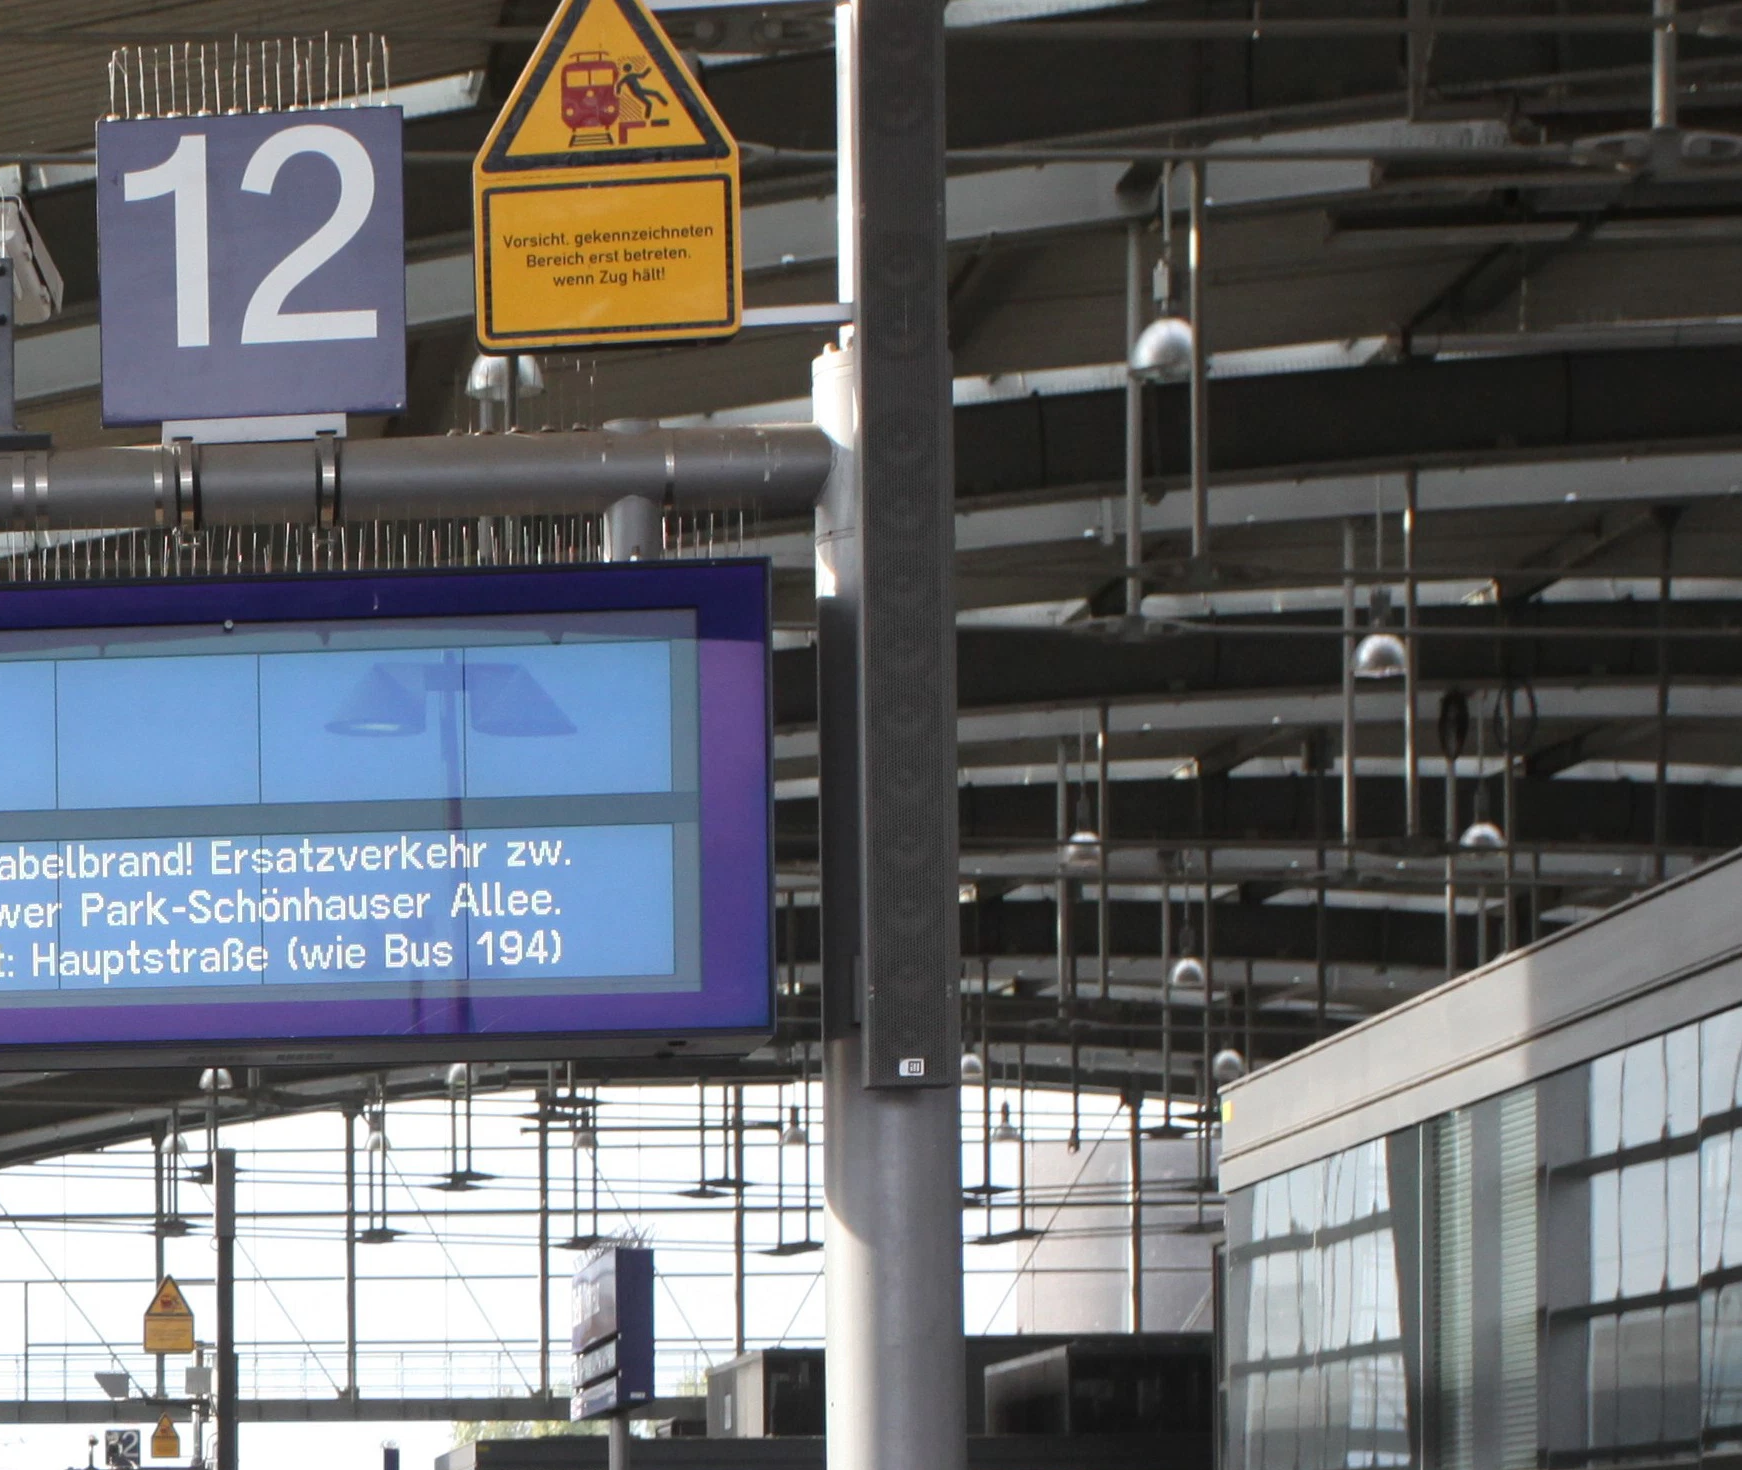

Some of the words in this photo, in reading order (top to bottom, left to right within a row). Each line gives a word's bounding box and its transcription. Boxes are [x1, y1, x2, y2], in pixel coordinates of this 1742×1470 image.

[124, 124, 377, 347] 12
[575, 225, 714, 247] gekennzeichneten
[526, 251, 584, 268] Bereich
[589, 250, 618, 264] erst
[553, 273, 594, 287] wenn
[600, 270, 627, 286] Zug
[632, 267, 666, 281] hält!
[211, 834, 487, 875] Ersatzverkehr
[506, 840, 571, 867] zw.
[80, 886, 430, 928] Park-Schönhauser
[451, 882, 561, 918] Allee.
[32, 937, 268, 984] Hauptstraße
[288, 935, 366, 971] (wie
[385, 934, 453, 969] Bus
[476, 929, 561, 966] 194)
